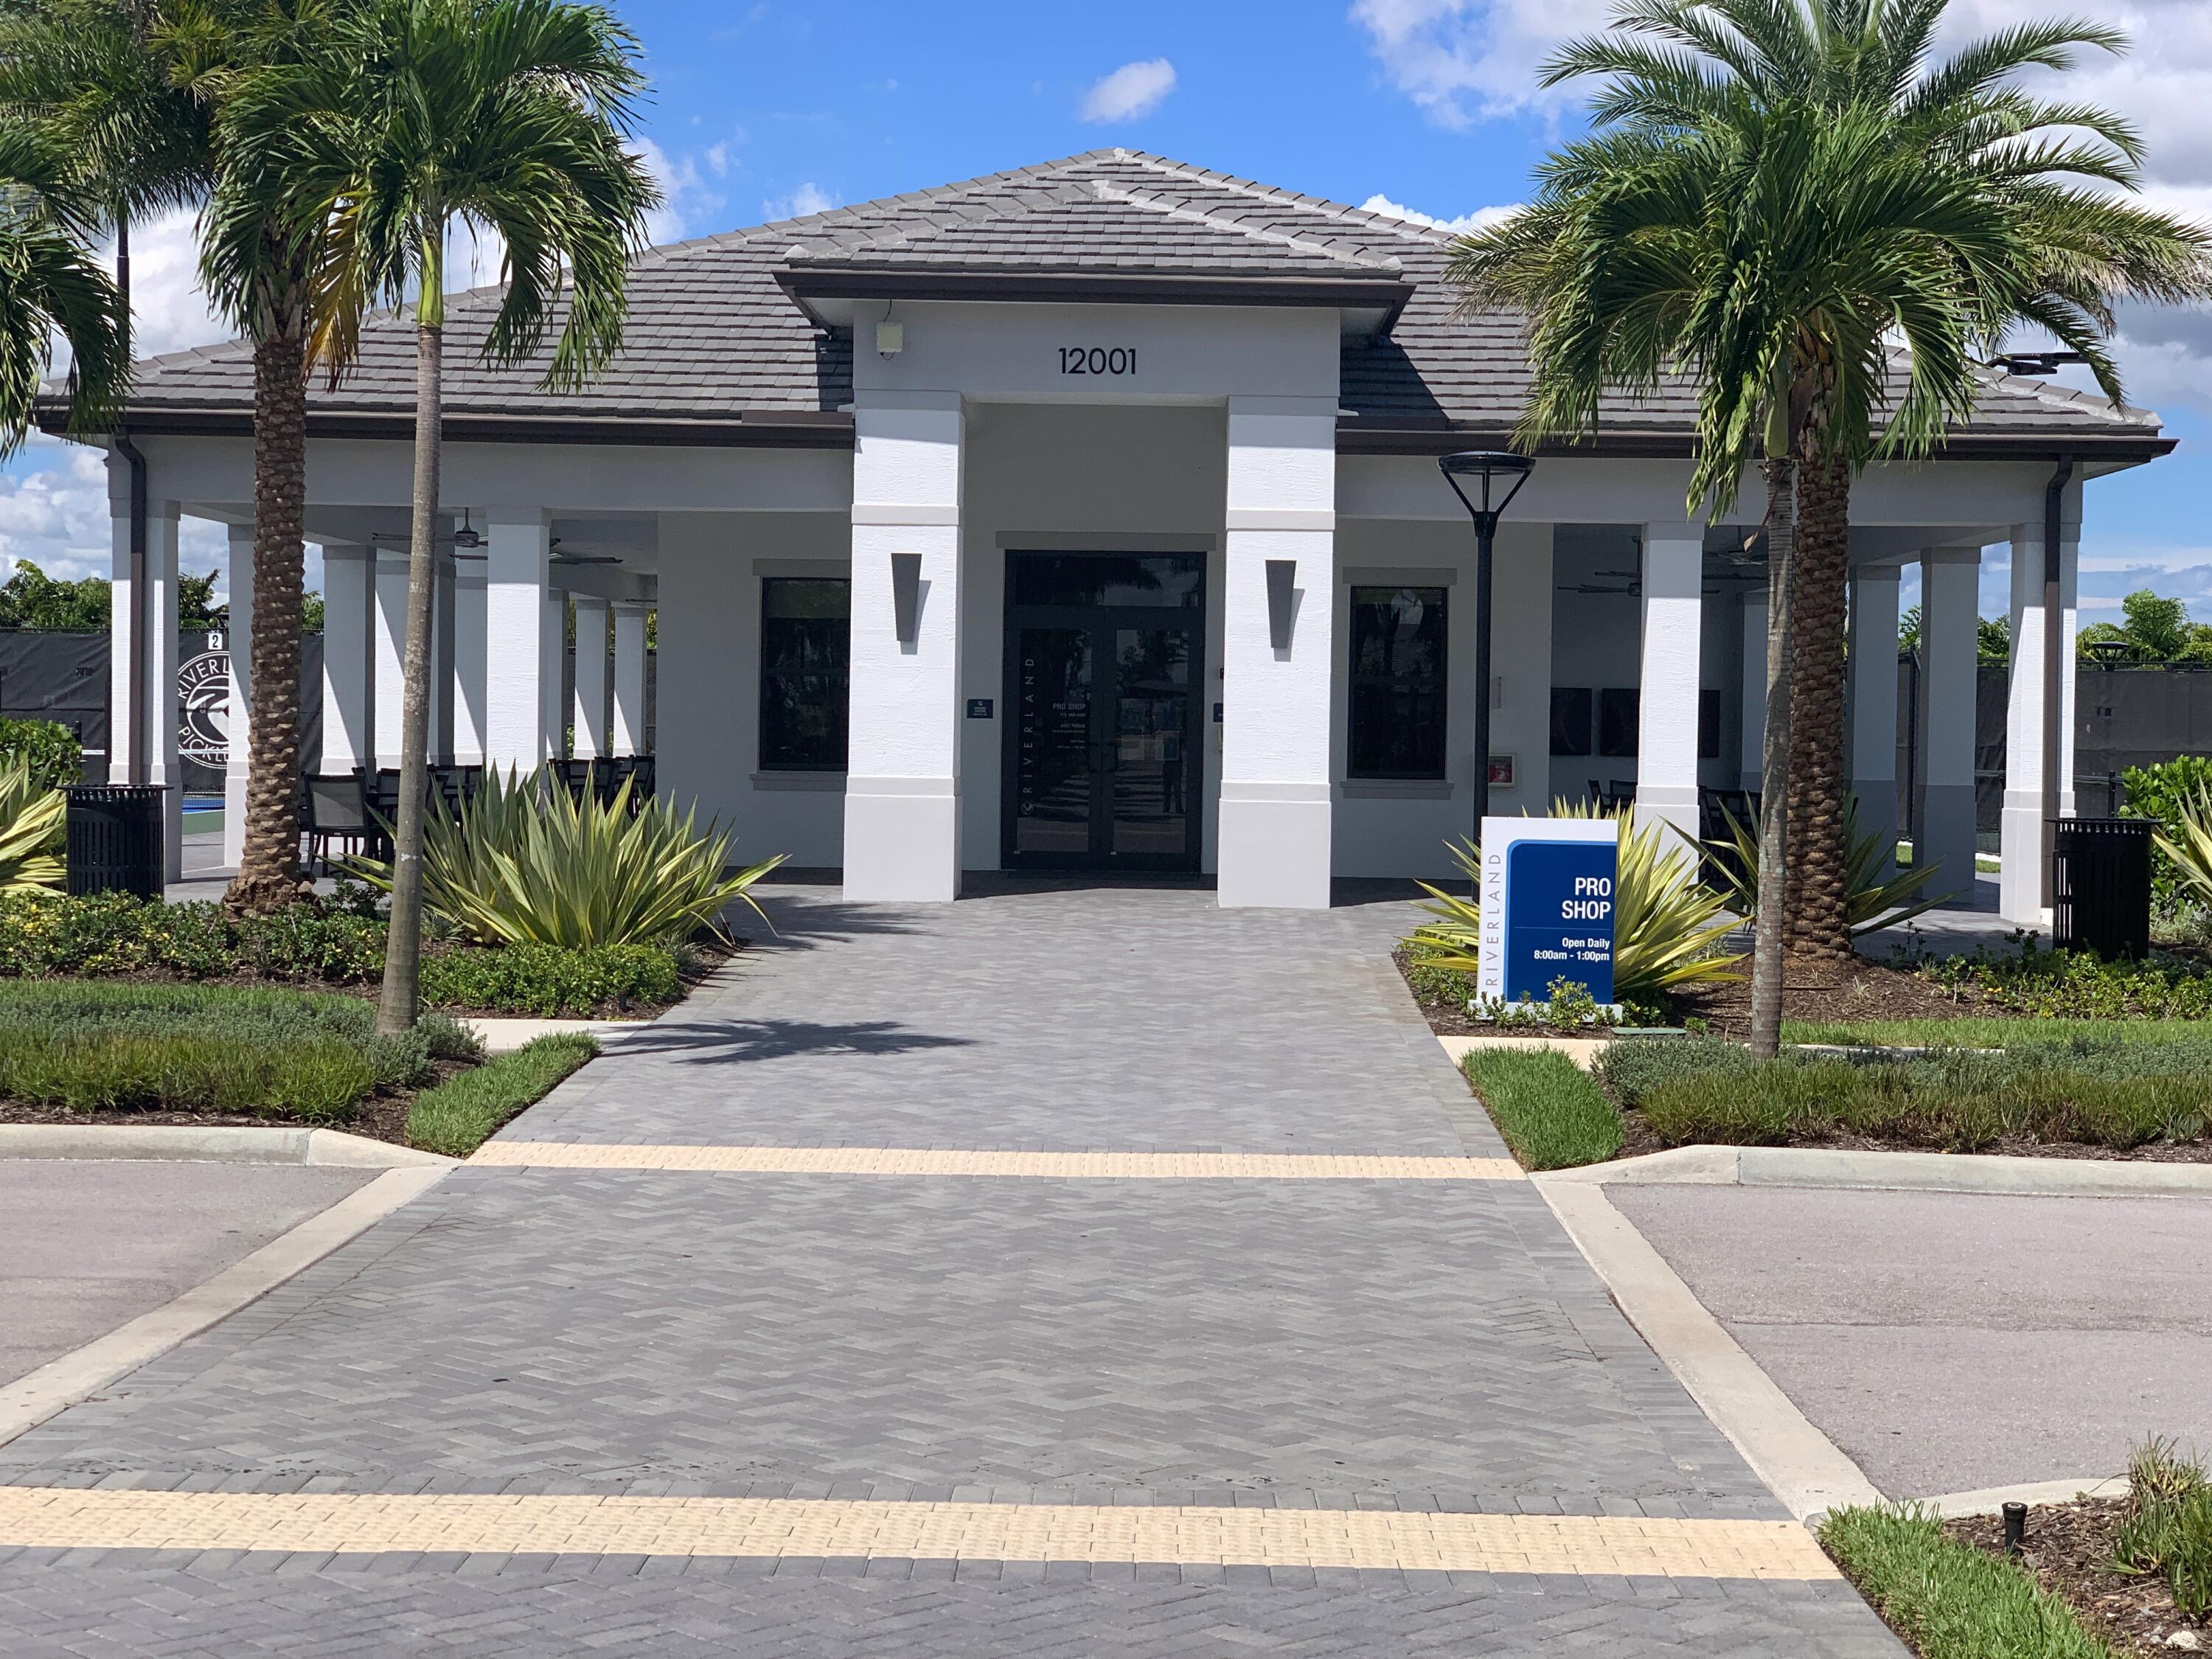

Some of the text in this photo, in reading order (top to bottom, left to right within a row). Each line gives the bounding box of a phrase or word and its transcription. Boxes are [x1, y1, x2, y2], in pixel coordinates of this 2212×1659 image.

[1058, 347, 1136, 375] 12001
[212, 634, 219, 648] 2
[178, 658, 229, 699] RIVERL
[1068, 703, 1086, 711] SHOP
[1022, 658, 1034, 794] RIVERLAND
[1575, 877, 1611, 897] PRO
[1562, 900, 1611, 919] SHOP
[1485, 854, 1501, 987] RIVERLAND
[1562, 937, 1610, 950] Open Daily
[1534, 950, 1568, 960] 8:00am
[1576, 950, 1610, 962] 1:00pm
